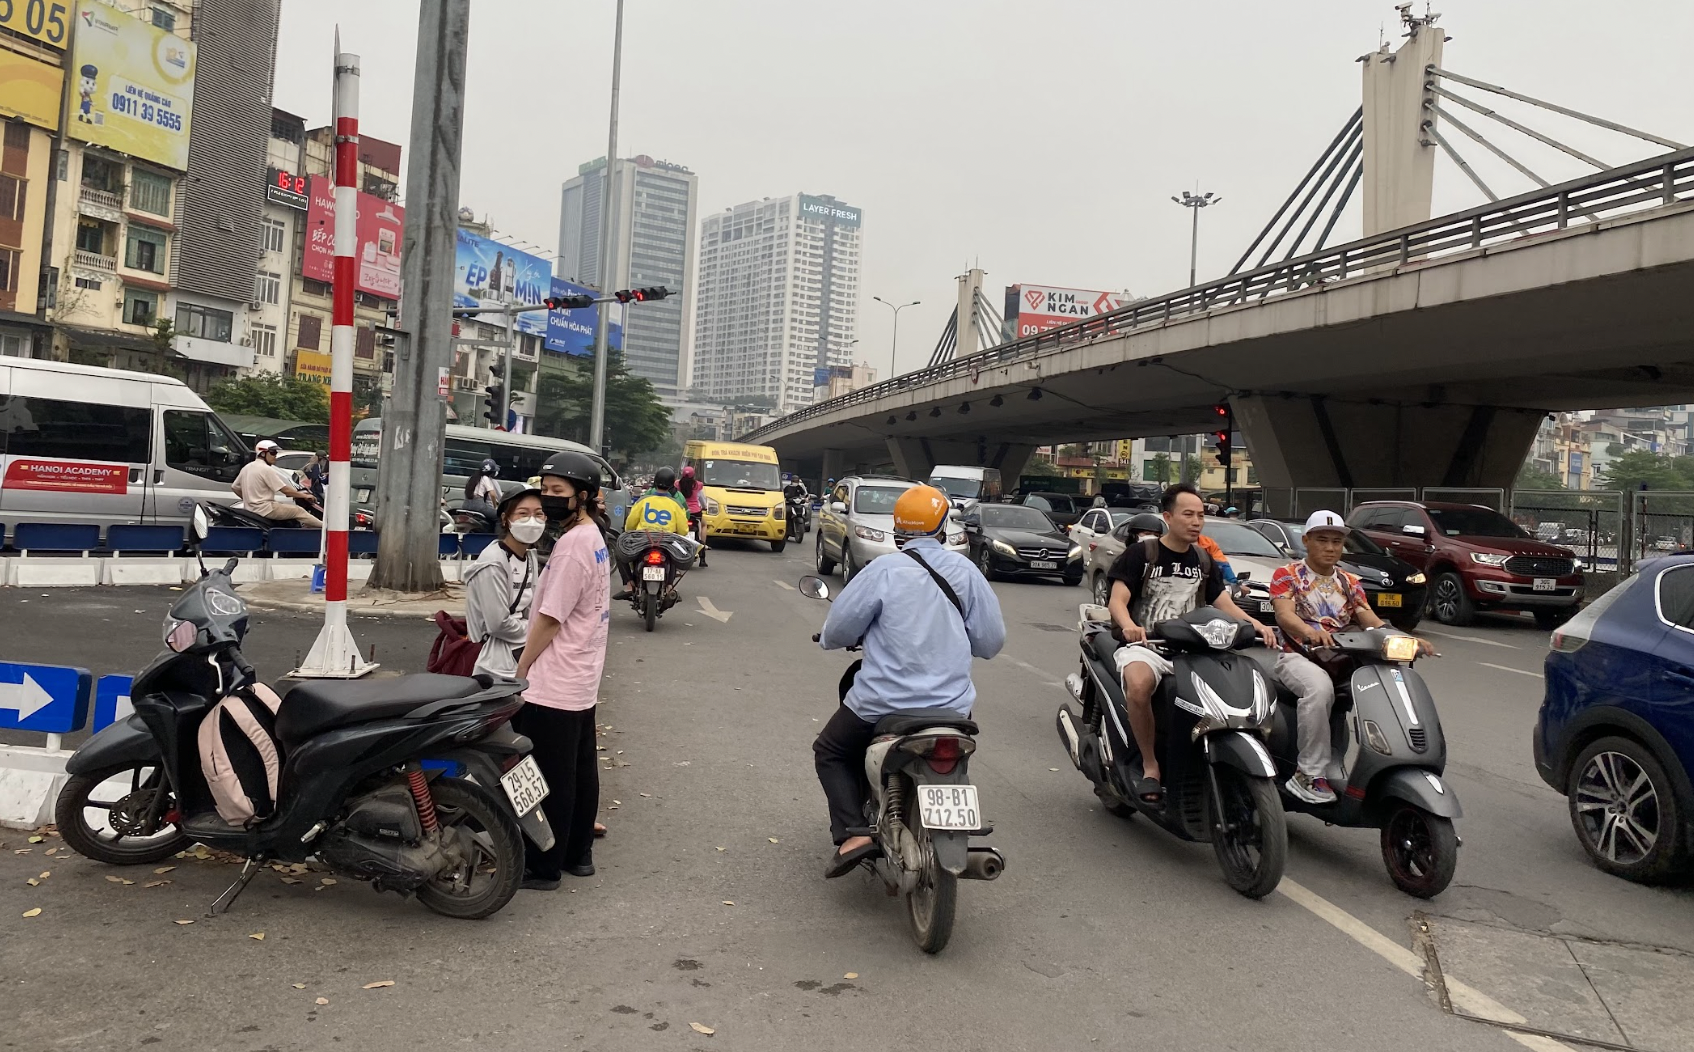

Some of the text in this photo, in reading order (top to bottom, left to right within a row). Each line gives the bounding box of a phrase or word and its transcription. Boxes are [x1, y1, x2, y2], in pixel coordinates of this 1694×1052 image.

[26, 0, 66, 43] 05
[112, 92, 182, 131] 0911 39 5555
[803, 202, 857, 221] LAYER FRESH
[465, 260, 488, 288] ÉP
[1048, 292, 1075, 304] KIM
[1047, 302, 1089, 316] NGAN
[568, 320, 580, 332] HÒA
[580, 324, 592, 336] PHÁT
[298, 372, 322, 384] TRANG
[30, 464, 112, 476] HANOI ACADEMY
[644, 502, 672, 526] be
[508, 761, 535, 794] 29-L5
[514, 776, 545, 813] 568.57
[928, 788, 968, 806] 98-B1
[924, 808, 976, 826] 712.50
